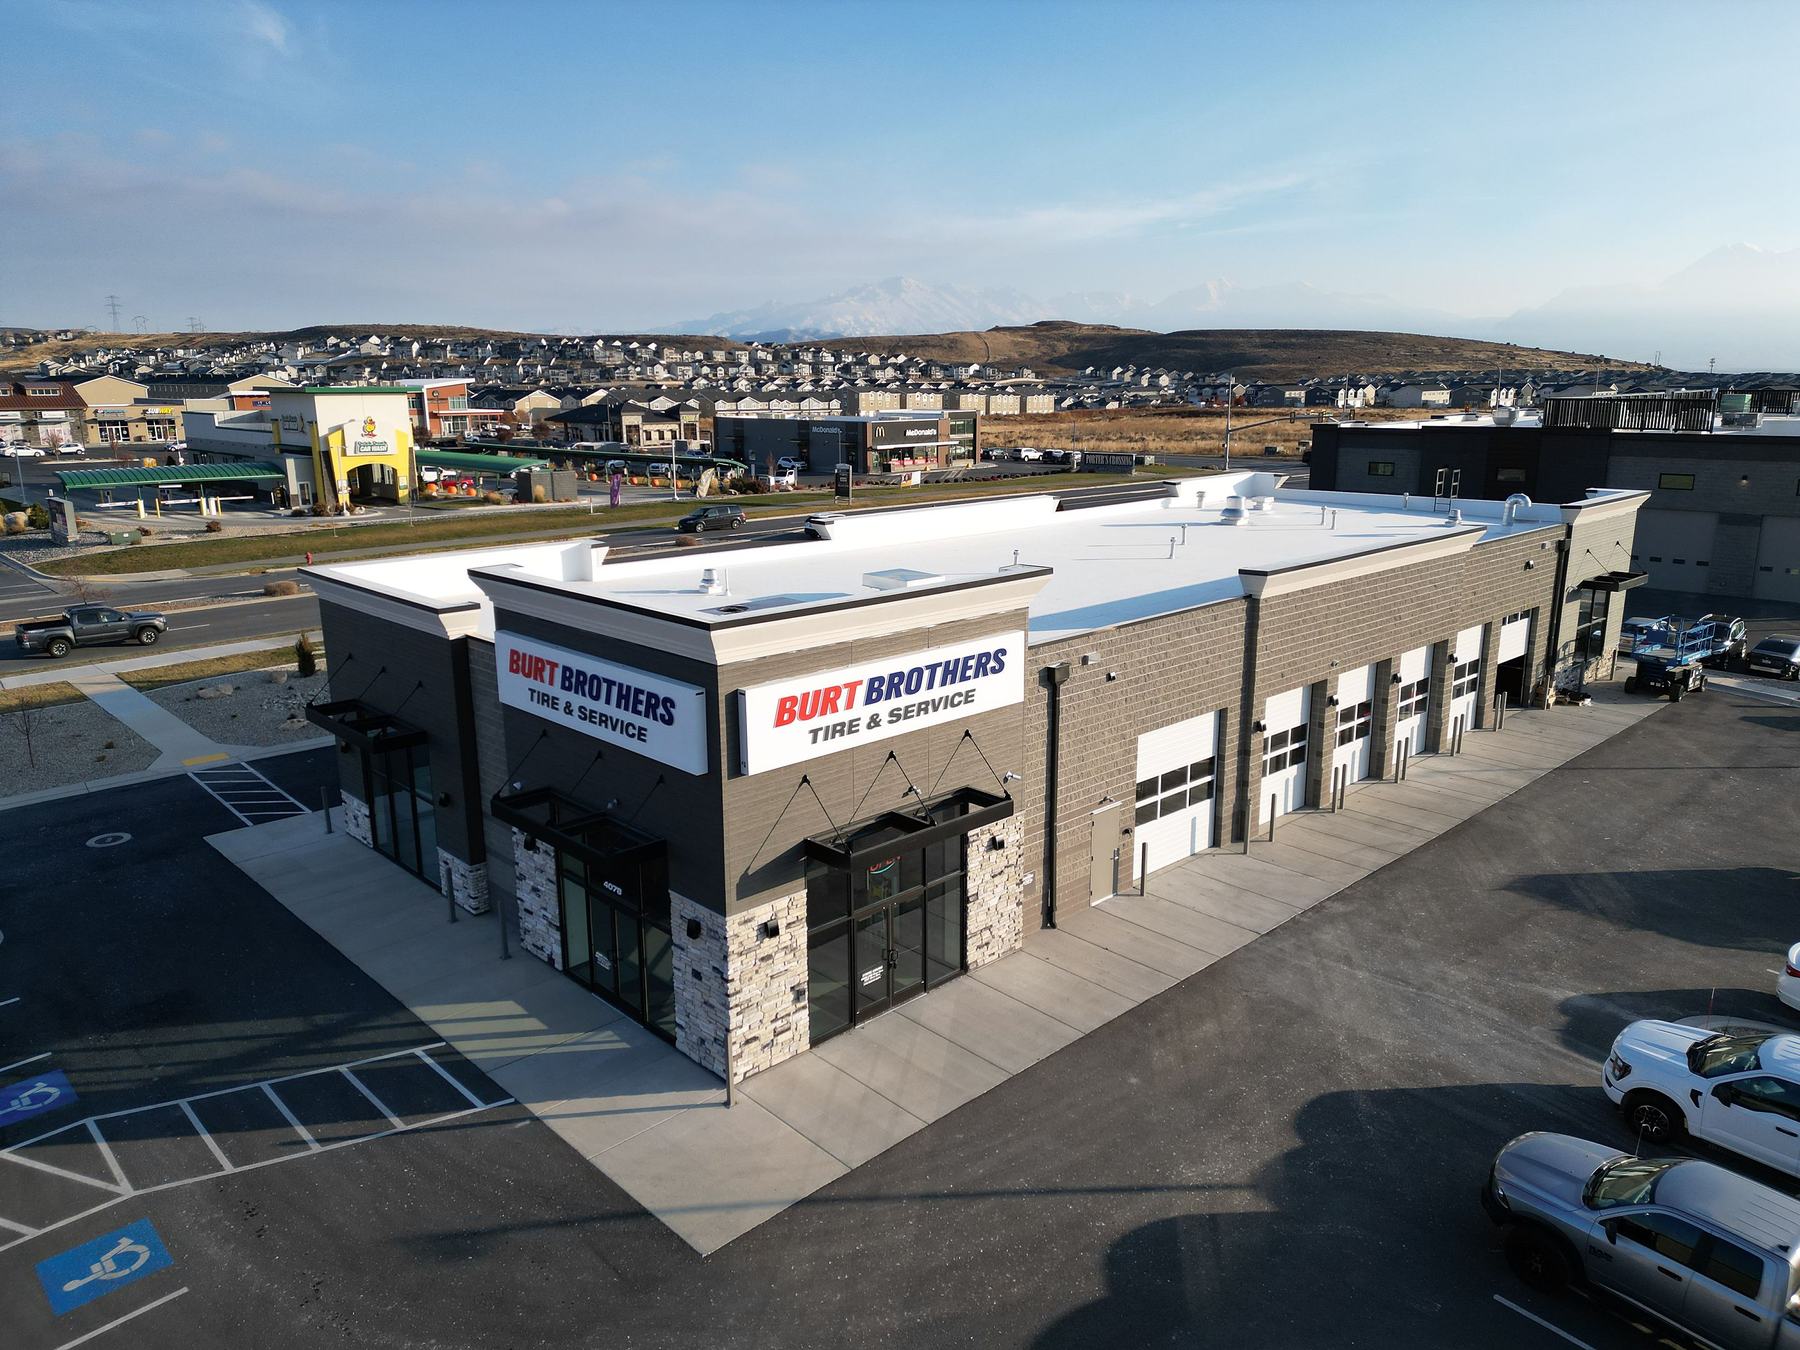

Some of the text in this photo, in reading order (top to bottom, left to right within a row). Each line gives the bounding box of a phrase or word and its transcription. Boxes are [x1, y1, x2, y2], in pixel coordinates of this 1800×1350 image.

[509, 649, 676, 727] BURT BROTHERS
[528, 688, 648, 743] TIRE & SERVICE
[773, 648, 1007, 728] BURT BROTHERS
[808, 689, 976, 744] TIRE & SERVICE
